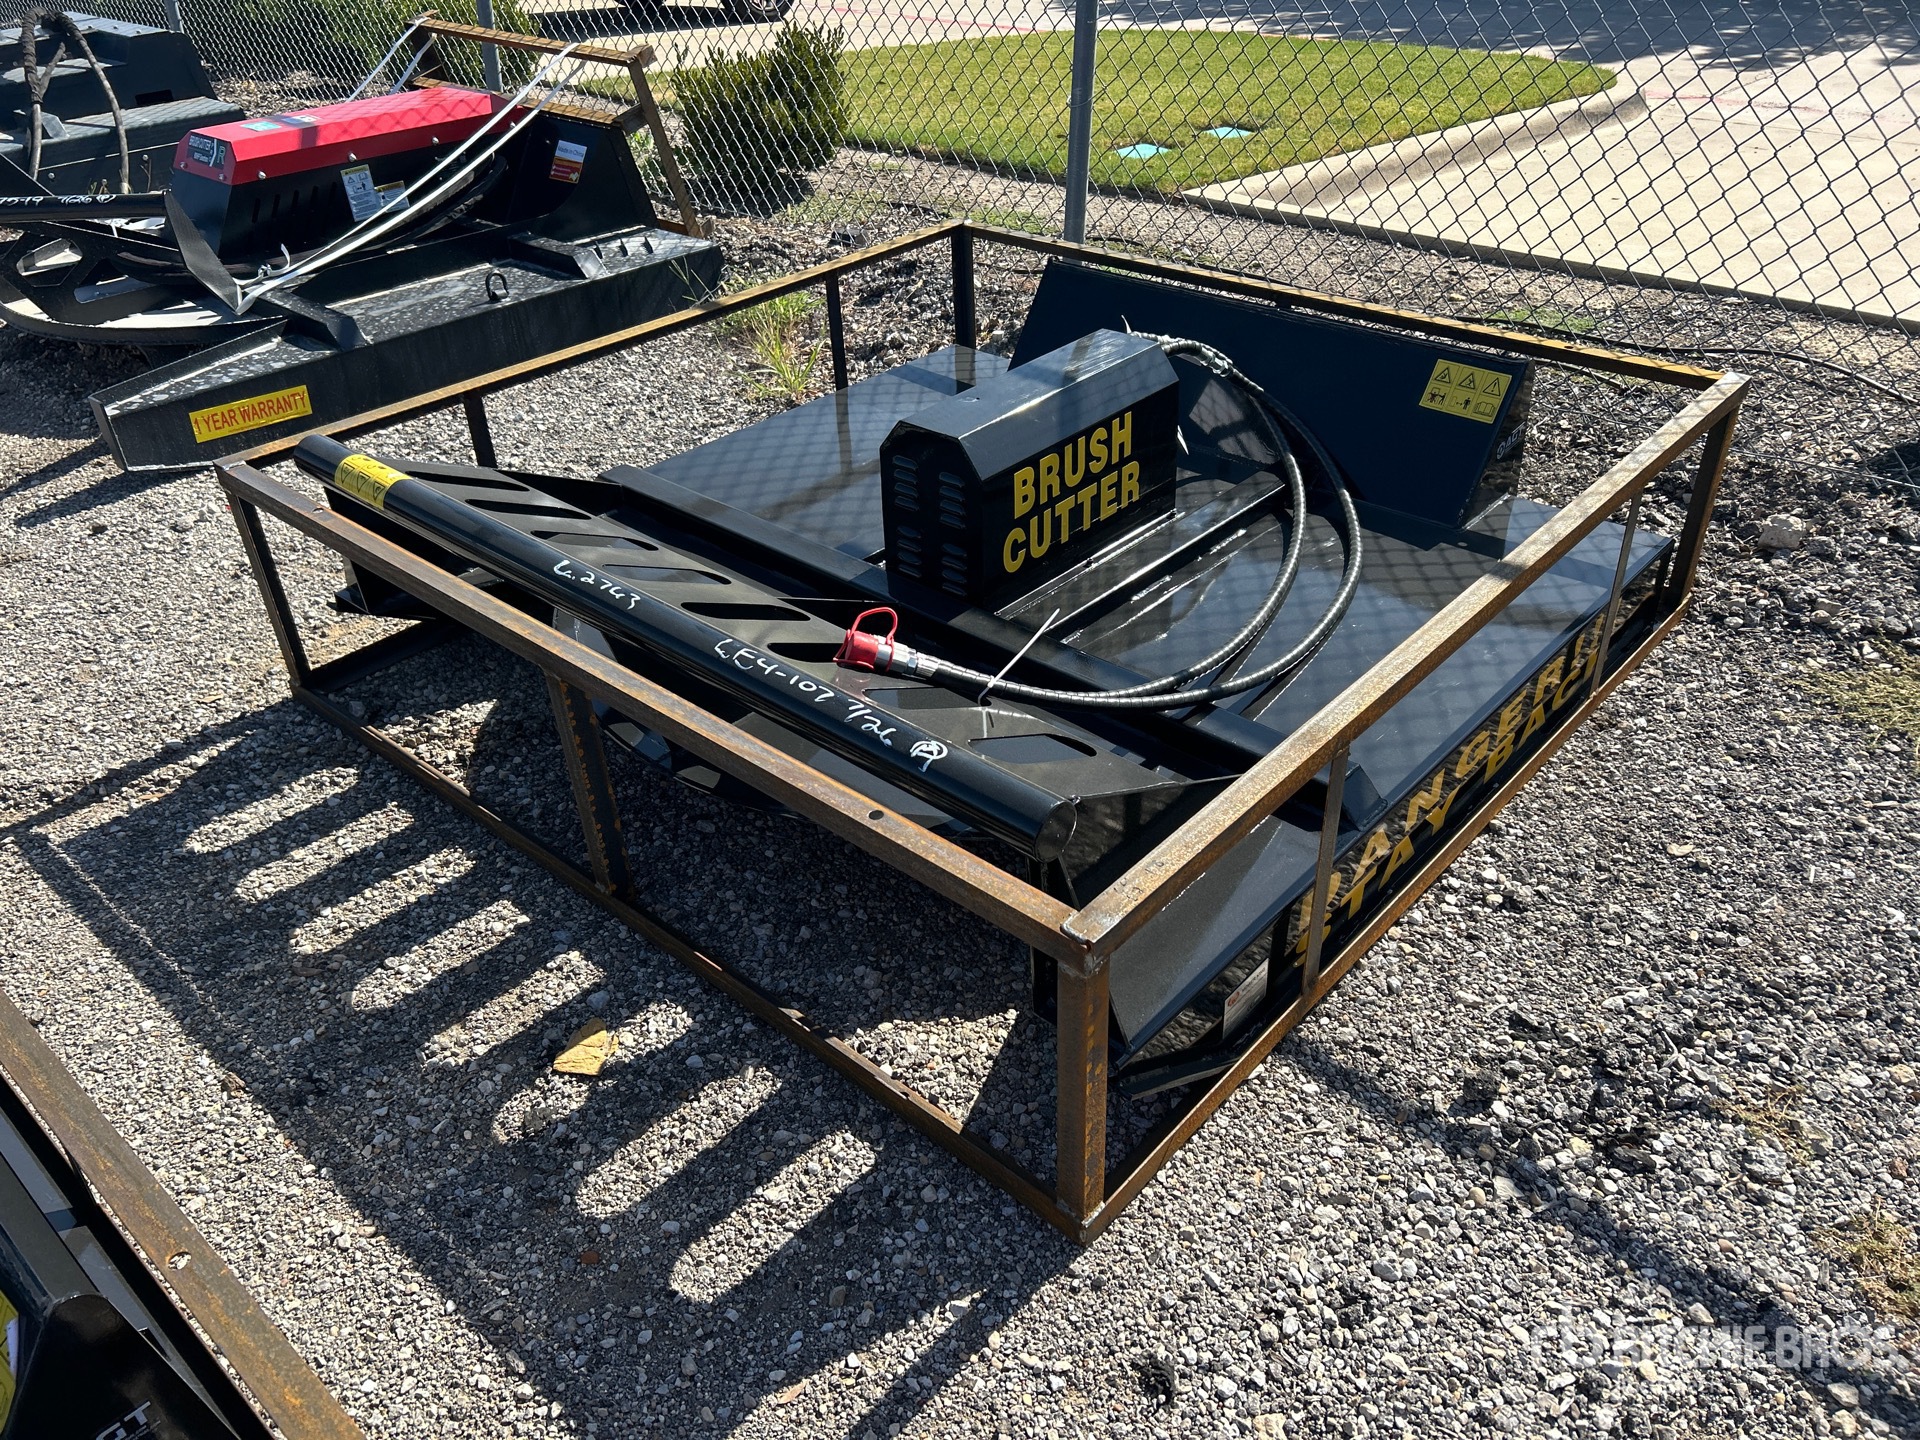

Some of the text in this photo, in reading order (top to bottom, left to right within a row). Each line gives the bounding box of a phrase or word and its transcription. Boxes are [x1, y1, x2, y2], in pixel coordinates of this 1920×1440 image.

[193, 417, 202, 435] 1
[202, 408, 240, 433] YEAR
[238, 390, 306, 424] WARRANTY
[1013, 410, 1133, 520] BRUSH
[1002, 460, 1141, 574] CUTTER
